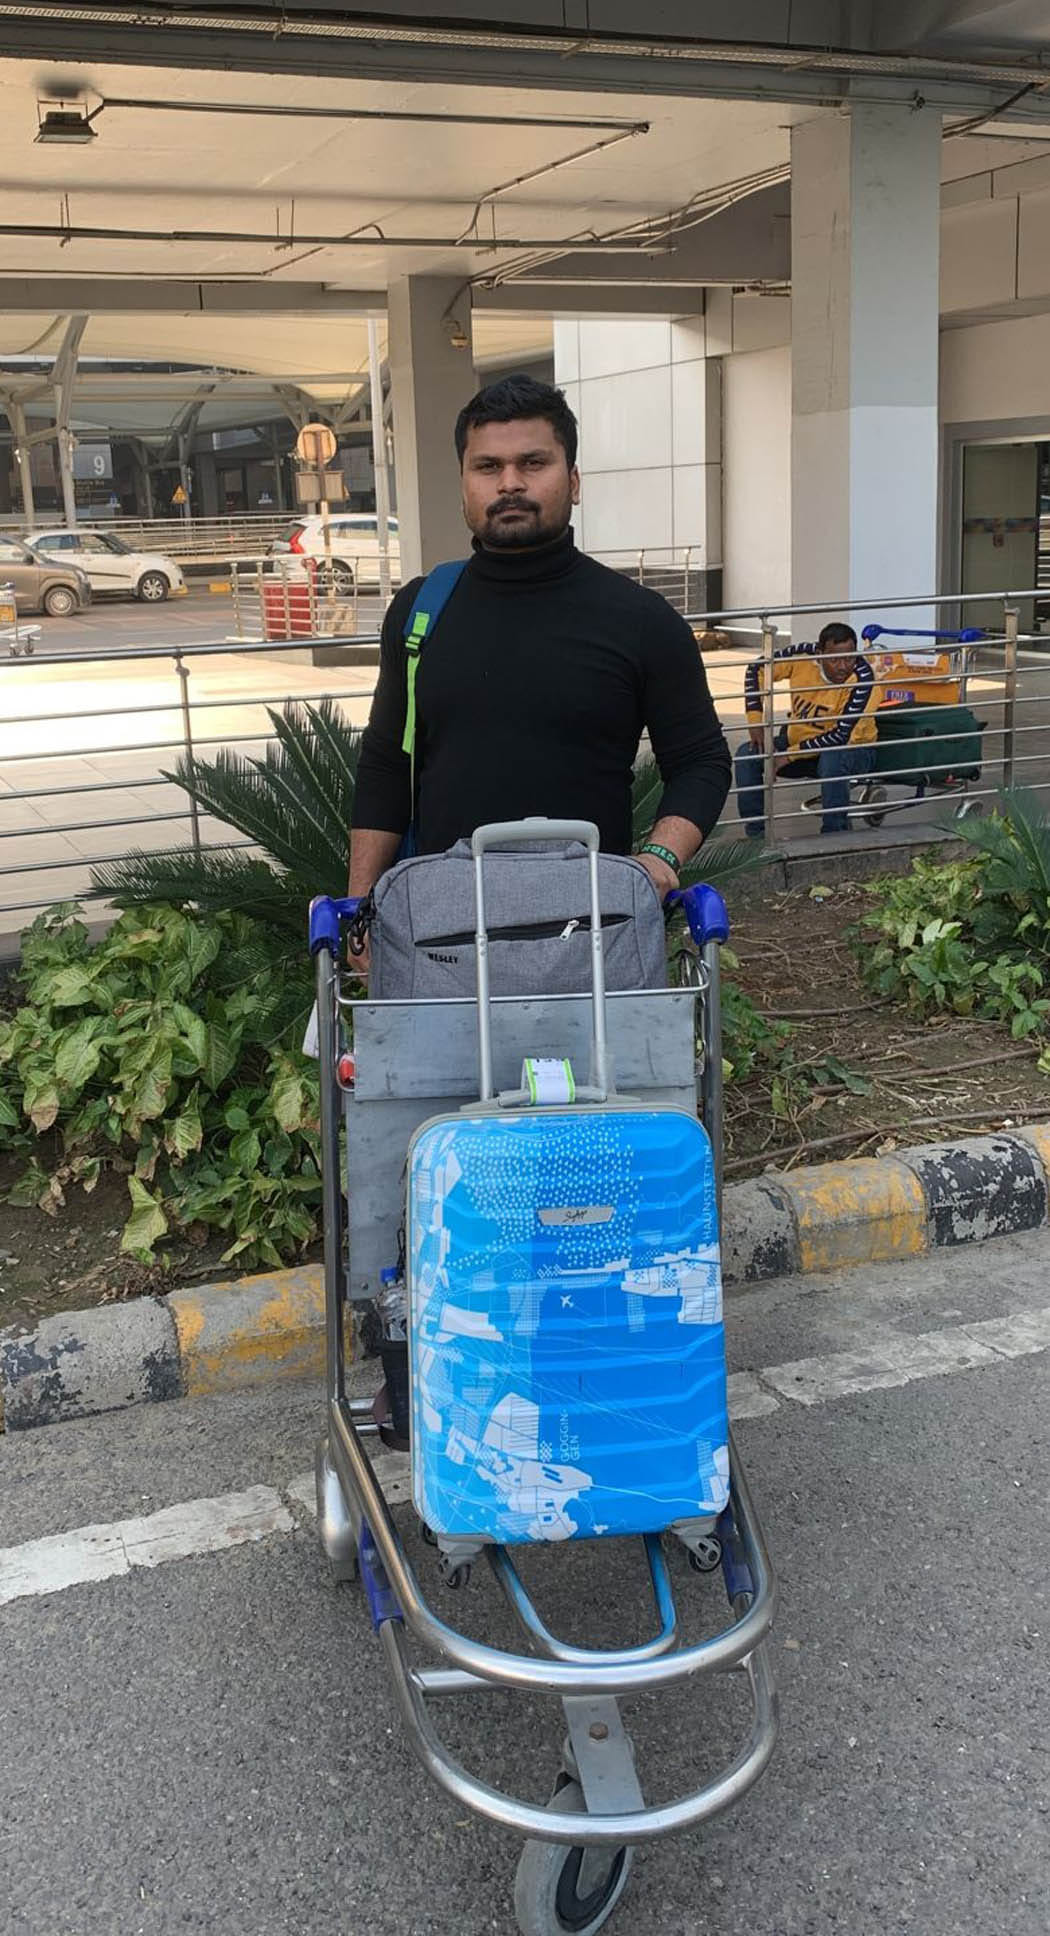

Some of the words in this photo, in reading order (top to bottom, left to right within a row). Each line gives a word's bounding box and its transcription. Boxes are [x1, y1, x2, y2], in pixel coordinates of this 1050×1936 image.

[94, 455, 105, 475] 9
[427, 951, 459, 964] WESLEY
[570, 1435, 580, 1461] GEN
